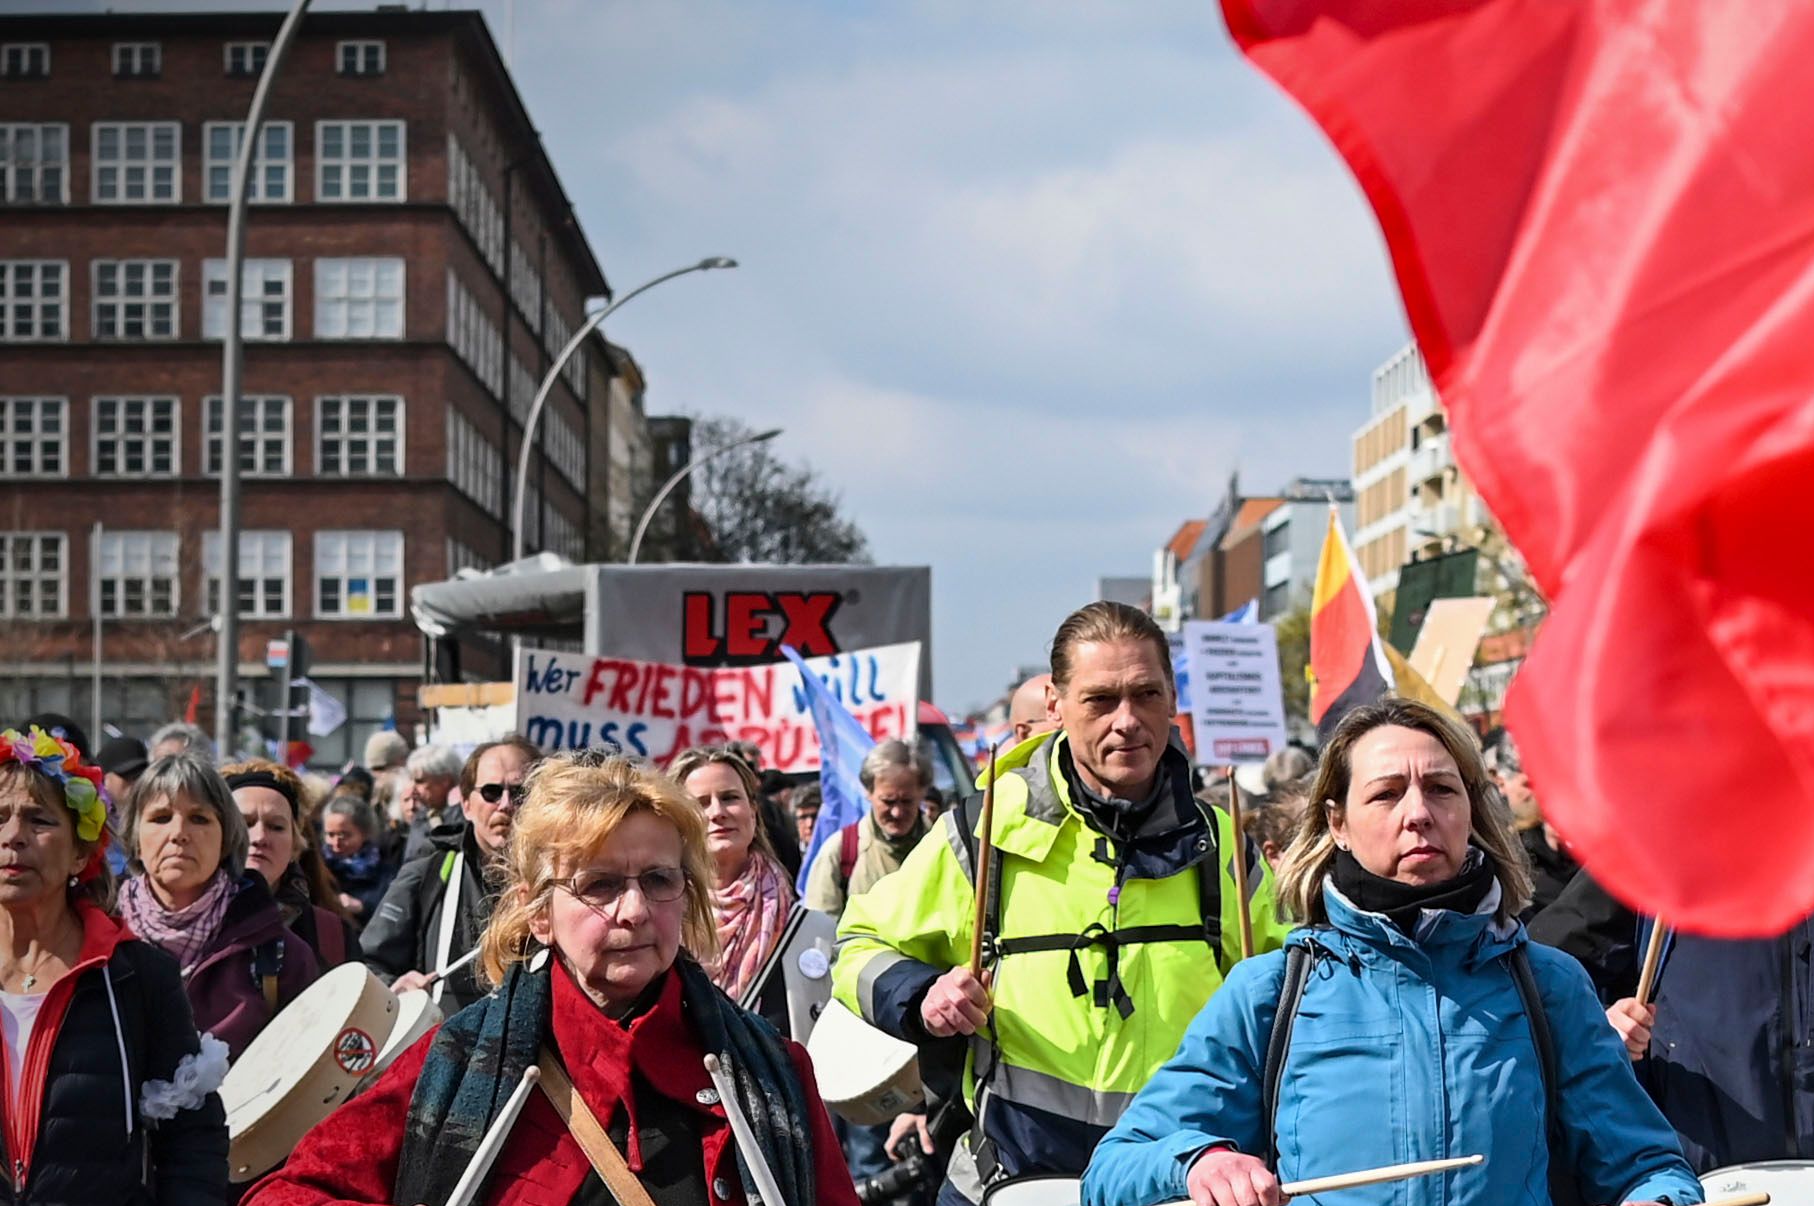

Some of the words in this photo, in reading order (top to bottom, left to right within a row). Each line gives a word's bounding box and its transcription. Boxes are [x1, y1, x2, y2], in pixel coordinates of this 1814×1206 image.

[683, 592, 843, 665] LEX
[527, 655, 581, 694] Wer
[583, 658, 776, 724] FRIEDEN
[526, 715, 648, 757] muss
